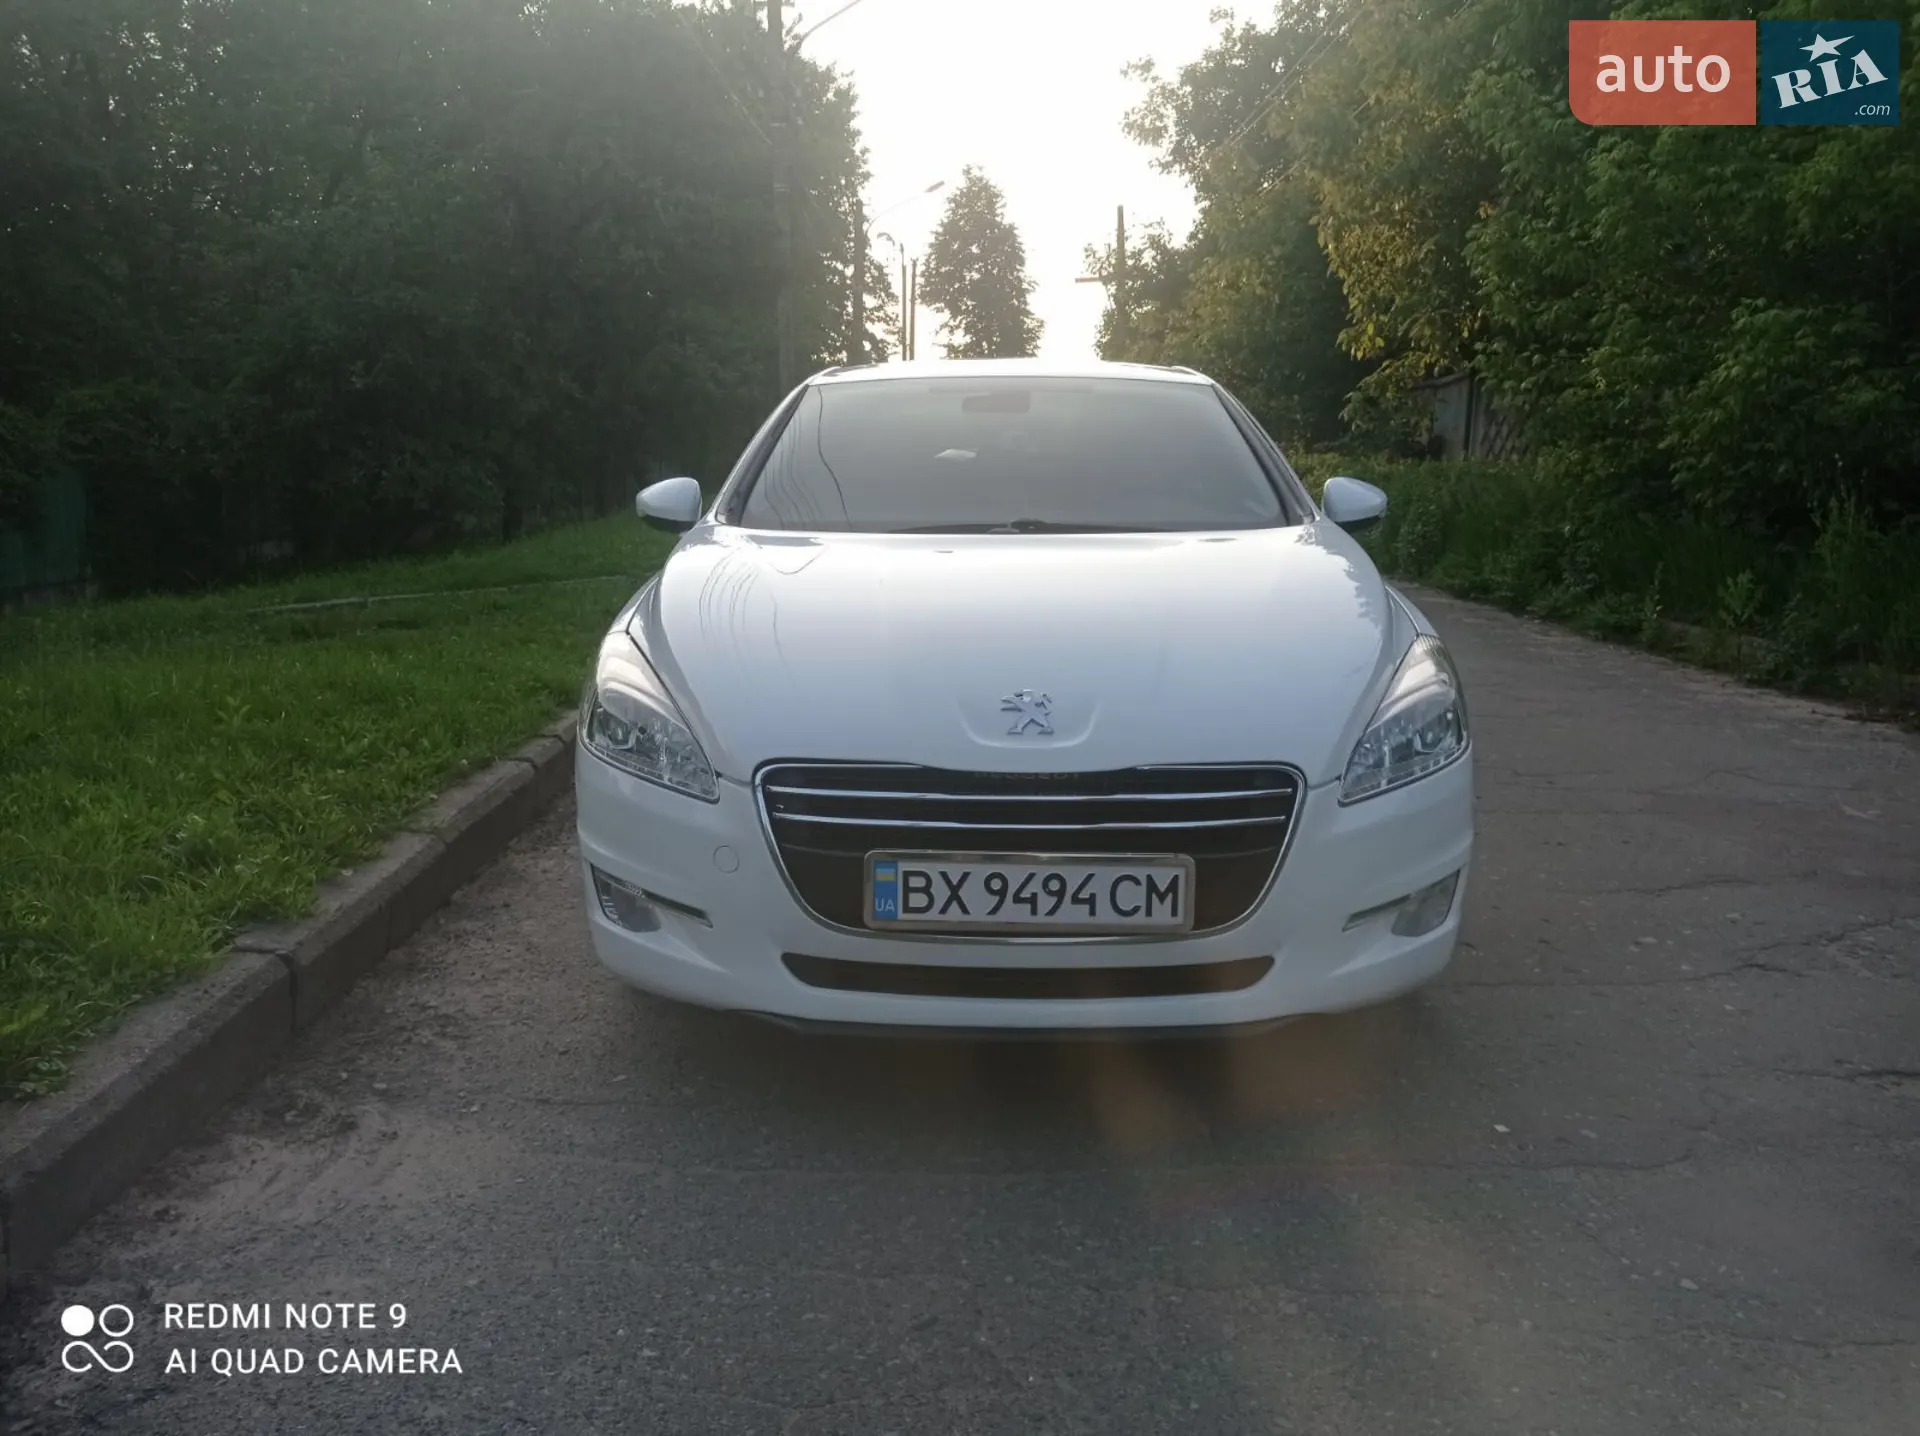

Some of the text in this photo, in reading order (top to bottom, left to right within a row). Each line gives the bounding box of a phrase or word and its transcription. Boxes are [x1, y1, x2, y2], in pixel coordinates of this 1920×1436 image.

[875, 898, 895, 912] UA
[901, 869, 1180, 918] BX 9494 CM
